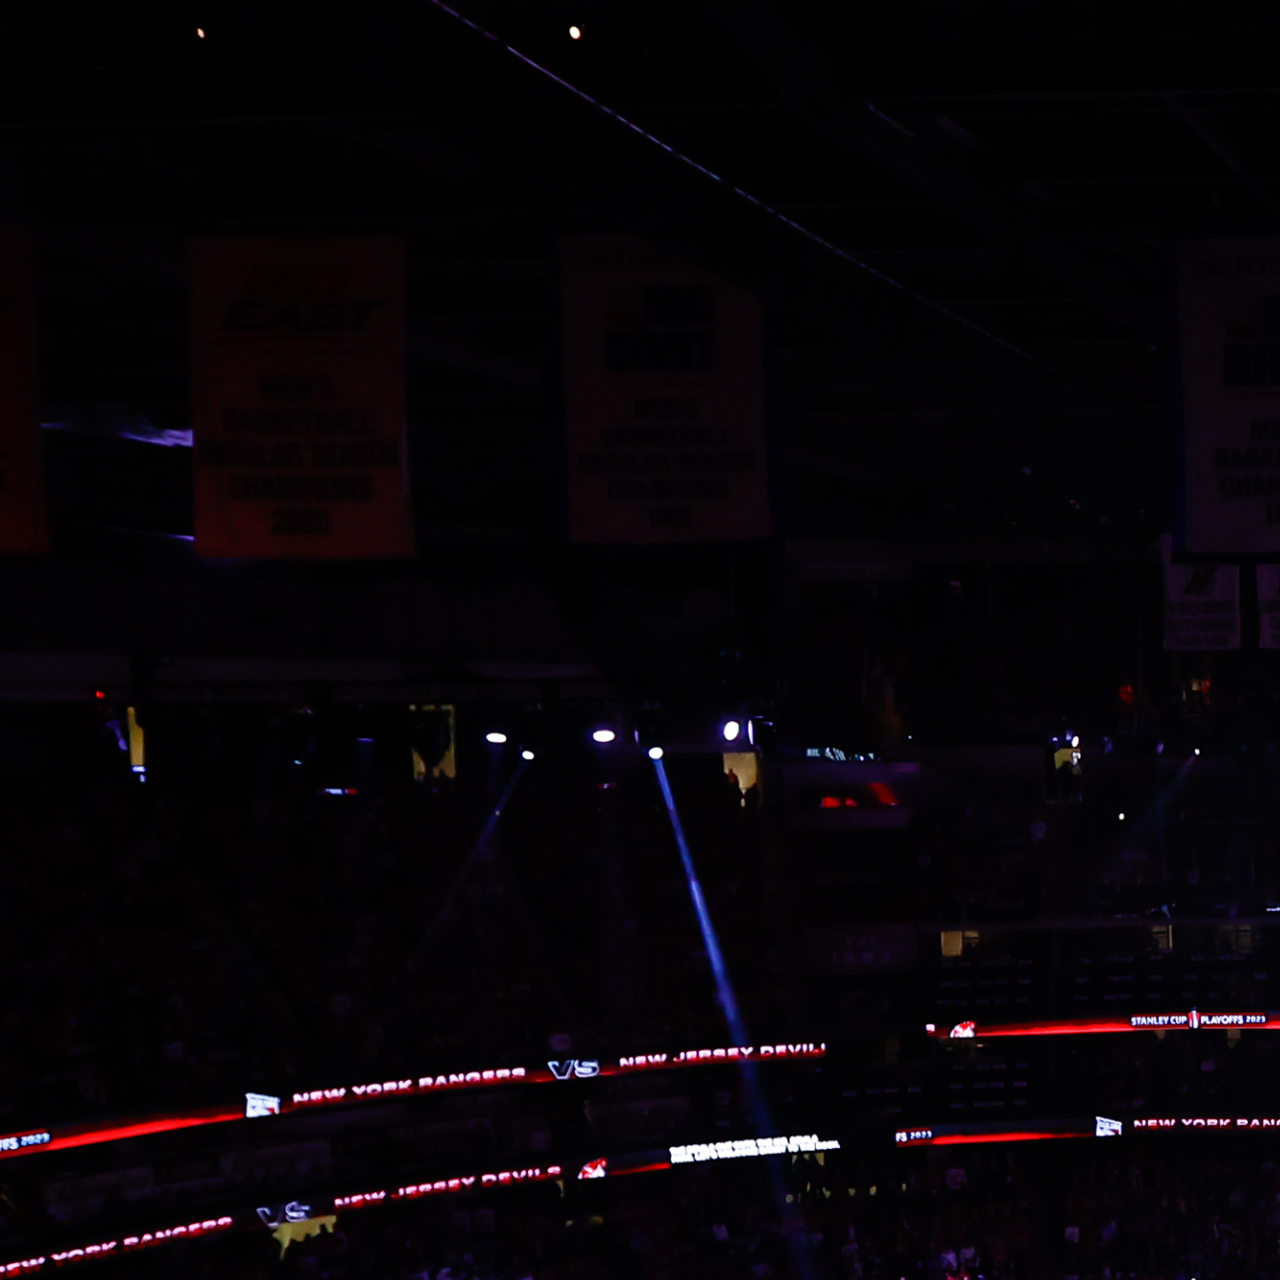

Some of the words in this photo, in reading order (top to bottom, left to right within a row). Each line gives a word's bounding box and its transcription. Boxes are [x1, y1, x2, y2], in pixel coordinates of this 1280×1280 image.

[1130, 1015, 1169, 1026] STANLEY
[1170, 1015, 1187, 1025] CUP
[1200, 1014, 1244, 1025] PLAYOFFS
[1246, 1014, 1266, 1024] 2023
[292, 1086, 347, 1105] NEW
[351, 1078, 412, 1098] YORK
[418, 1066, 527, 1090] RANGERS
[547, 1059, 600, 1080] VS
[619, 1053, 668, 1069] NEW
[672, 1045, 754, 1064] JERSEY
[1133, 1118, 1176, 1130] NEW
[1180, 1118, 1231, 1130] YORK
[910, 1129, 933, 1140] 2023
[51, 1241, 117, 1264] YORK
[122, 1216, 234, 1247] RANGERS
[334, 1190, 386, 1209] NEW
[397, 1176, 476, 1200] JERSEY
[481, 1165, 562, 1187] DEVILS
